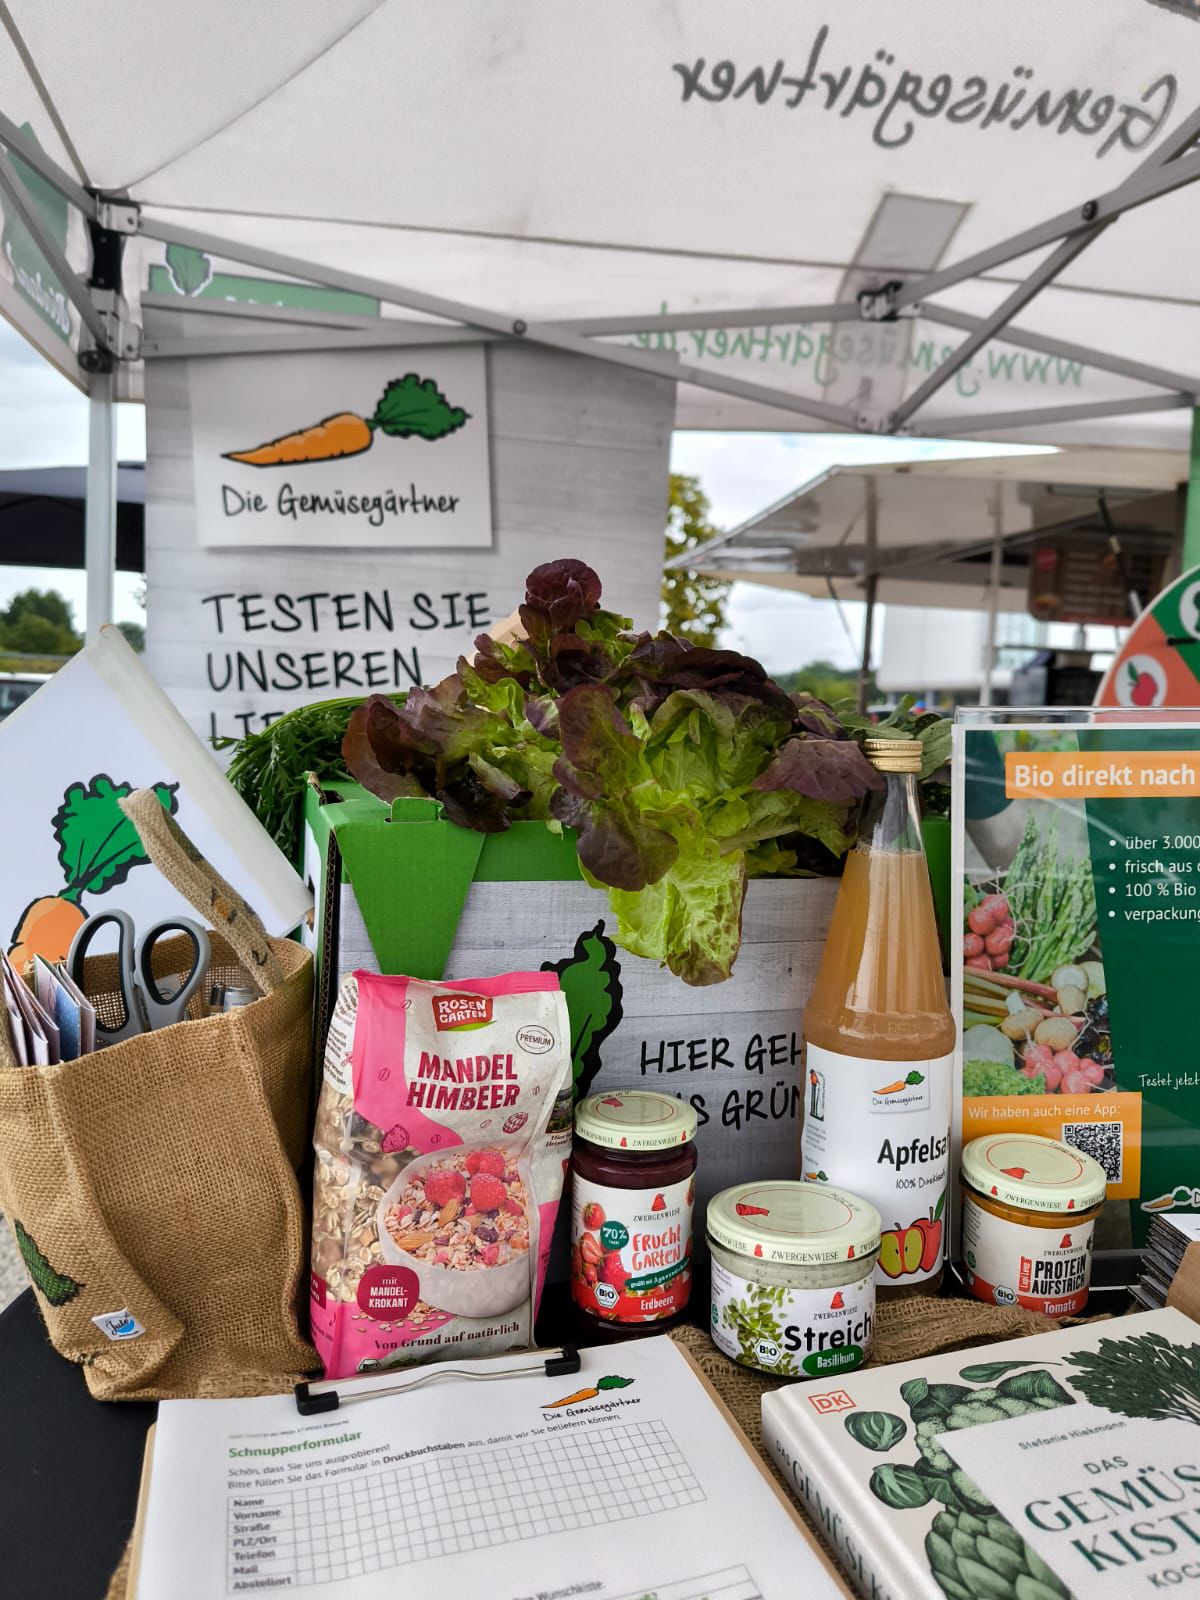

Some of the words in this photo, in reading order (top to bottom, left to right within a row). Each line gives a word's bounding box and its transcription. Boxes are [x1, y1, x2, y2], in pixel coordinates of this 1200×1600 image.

[221, 484, 268, 517] Die
[278, 483, 460, 527] Gemüsegärtner
[202, 590, 394, 633] TESTEN
[409, 592, 492, 631] SIE
[207, 646, 423, 693] UNSEREN
[1015, 766, 1053, 787] Bio
[1062, 764, 1133, 786] direkt
[1140, 764, 1195, 785] nach
[1125, 836, 1158, 850] über
[1125, 860, 1165, 874] frisch
[1169, 863, 1193, 874] aus
[1125, 884, 1152, 897] 100
[1157, 883, 1170, 896] %
[1174, 883, 1197, 896] Bio
[1124, 907, 1200, 924] verpackun
[439, 999, 487, 1013] ROSEN
[439, 1010, 487, 1024] GARTEN
[519, 1033, 551, 1046] PREMIUM
[640, 1037, 734, 1075] HIER
[417, 1052, 518, 1084] MANDEL
[1138, 1072, 1172, 1087] Testet
[1174, 1072, 1200, 1090] jetzt
[406, 1082, 520, 1111] HIMBEER
[969, 1107, 989, 1119] Wir
[993, 1105, 1029, 1117] haben
[1033, 1104, 1062, 1117] auch
[1065, 1105, 1090, 1116] eine
[1094, 1104, 1121, 1117] App:
[632, 1135, 678, 1147] ZWERGENWIESE
[896, 1178, 916, 1189] 100%
[1004, 1192, 1063, 1209] ZWERGENWIESE
[633, 1208, 681, 1222] ZWERGENWIESE
[602, 1226, 627, 1240] 70%
[771, 1250, 840, 1262] ZWERGENWIESE
[382, 1276, 397, 1286] mit
[370, 1286, 408, 1297] MANDEL-
[368, 1298, 409, 1309] KROKANT
[640, 1296, 674, 1311] Erdbeere
[1043, 1299, 1077, 1314] Tomate
[813, 1305, 858, 1321] ZWERGENWIESE
[374, 1339, 398, 1350] Von
[401, 1334, 441, 1348] Grund
[444, 1331, 465, 1343] auf
[467, 1321, 520, 1341] natürlich
[784, 1312, 872, 1352] Streich
[816, 1352, 855, 1370] Basilikum
[542, 1412, 563, 1422] Die
[566, 1397, 641, 1416] Gemüsegärtner
[816, 1395, 849, 1410] DK
[229, 1432, 363, 1458] Schnupperformular
[1018, 1433, 1068, 1450] Stefanie
[228, 1480, 252, 1490] Bitte
[255, 1478, 285, 1488] füllen
[287, 1474, 302, 1484] Sie
[305, 1471, 322, 1481] das
[325, 1461, 369, 1477] Formular
[371, 1458, 381, 1467] in
[382, 1441, 466, 1464] Druckbuchstaben
[467, 1439, 485, 1448] aus,
[487, 1434, 513, 1445] damit
[515, 1431, 529, 1440] wir
[531, 1427, 545, 1436] Sie
[547, 1419, 587, 1433] beliefern
[588, 1413, 622, 1425] können.
[228, 1467, 261, 1477] Schön,
[263, 1466, 284, 1475] dass
[287, 1462, 302, 1471] Sie
[305, 1460, 323, 1468] uns
[325, 1443, 391, 1465] ausprobieren!
[1083, 1455, 1129, 1474] DAS
[234, 1499, 264, 1507] Name
[233, 1509, 281, 1520] Vorname
[233, 1523, 270, 1534] Straße
[233, 1536, 277, 1547] PLZ/Ort
[1071, 1507, 1200, 1573] KIST
[234, 1550, 275, 1561] Telefon
[233, 1565, 258, 1574] Mail
[233, 1576, 291, 1590] Abstellort
